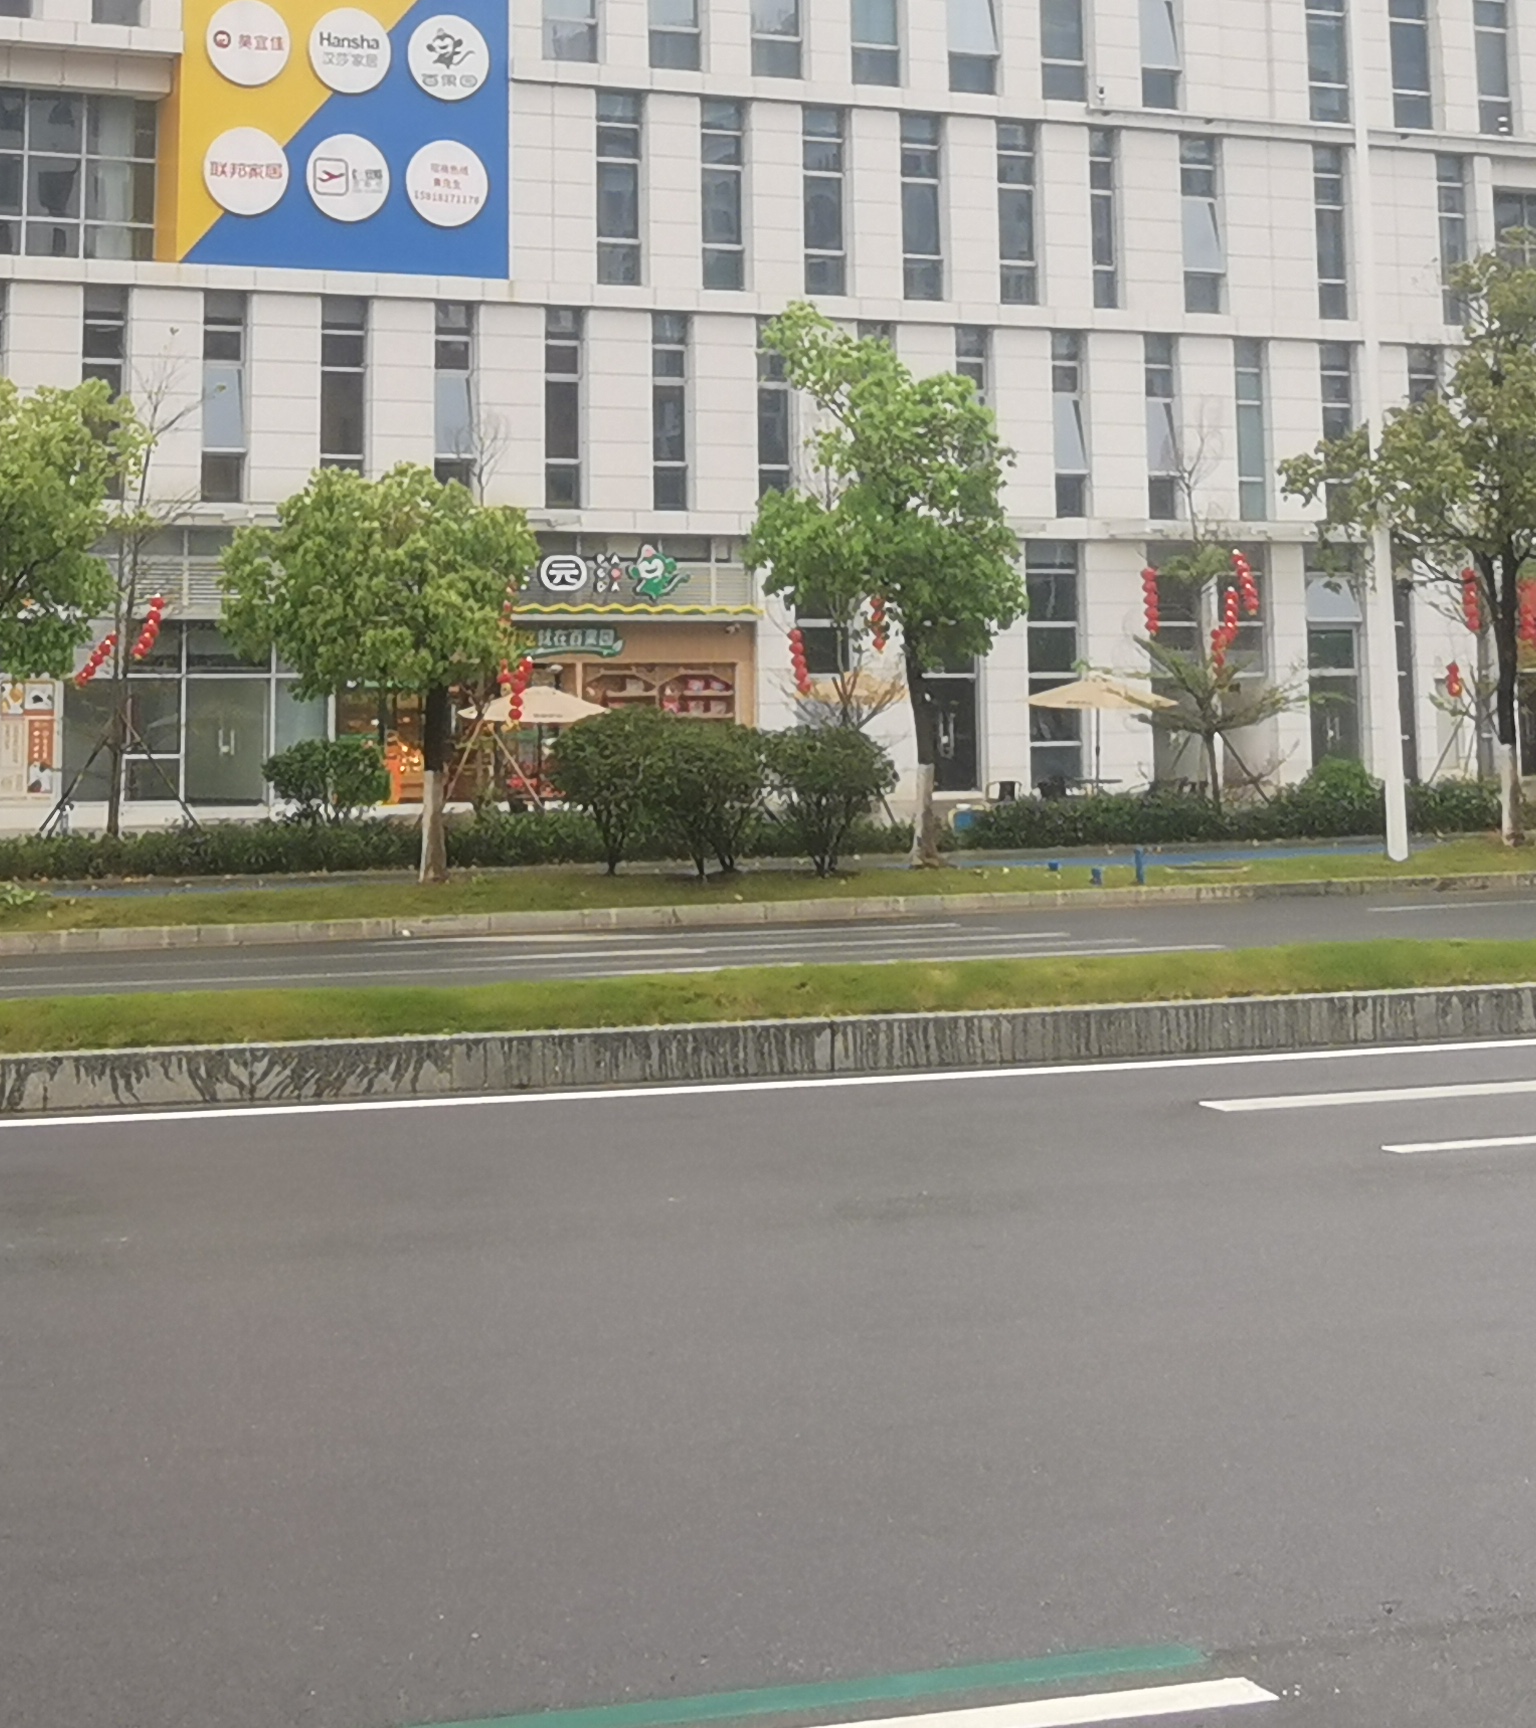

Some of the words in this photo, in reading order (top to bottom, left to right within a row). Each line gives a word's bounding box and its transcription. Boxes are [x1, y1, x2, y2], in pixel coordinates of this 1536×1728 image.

[238, 33, 285, 52] 美宜佳
[319, 31, 380, 50] Hansha
[322, 51, 378, 68] 汉莎家居
[421, 73, 478, 88] 百果园
